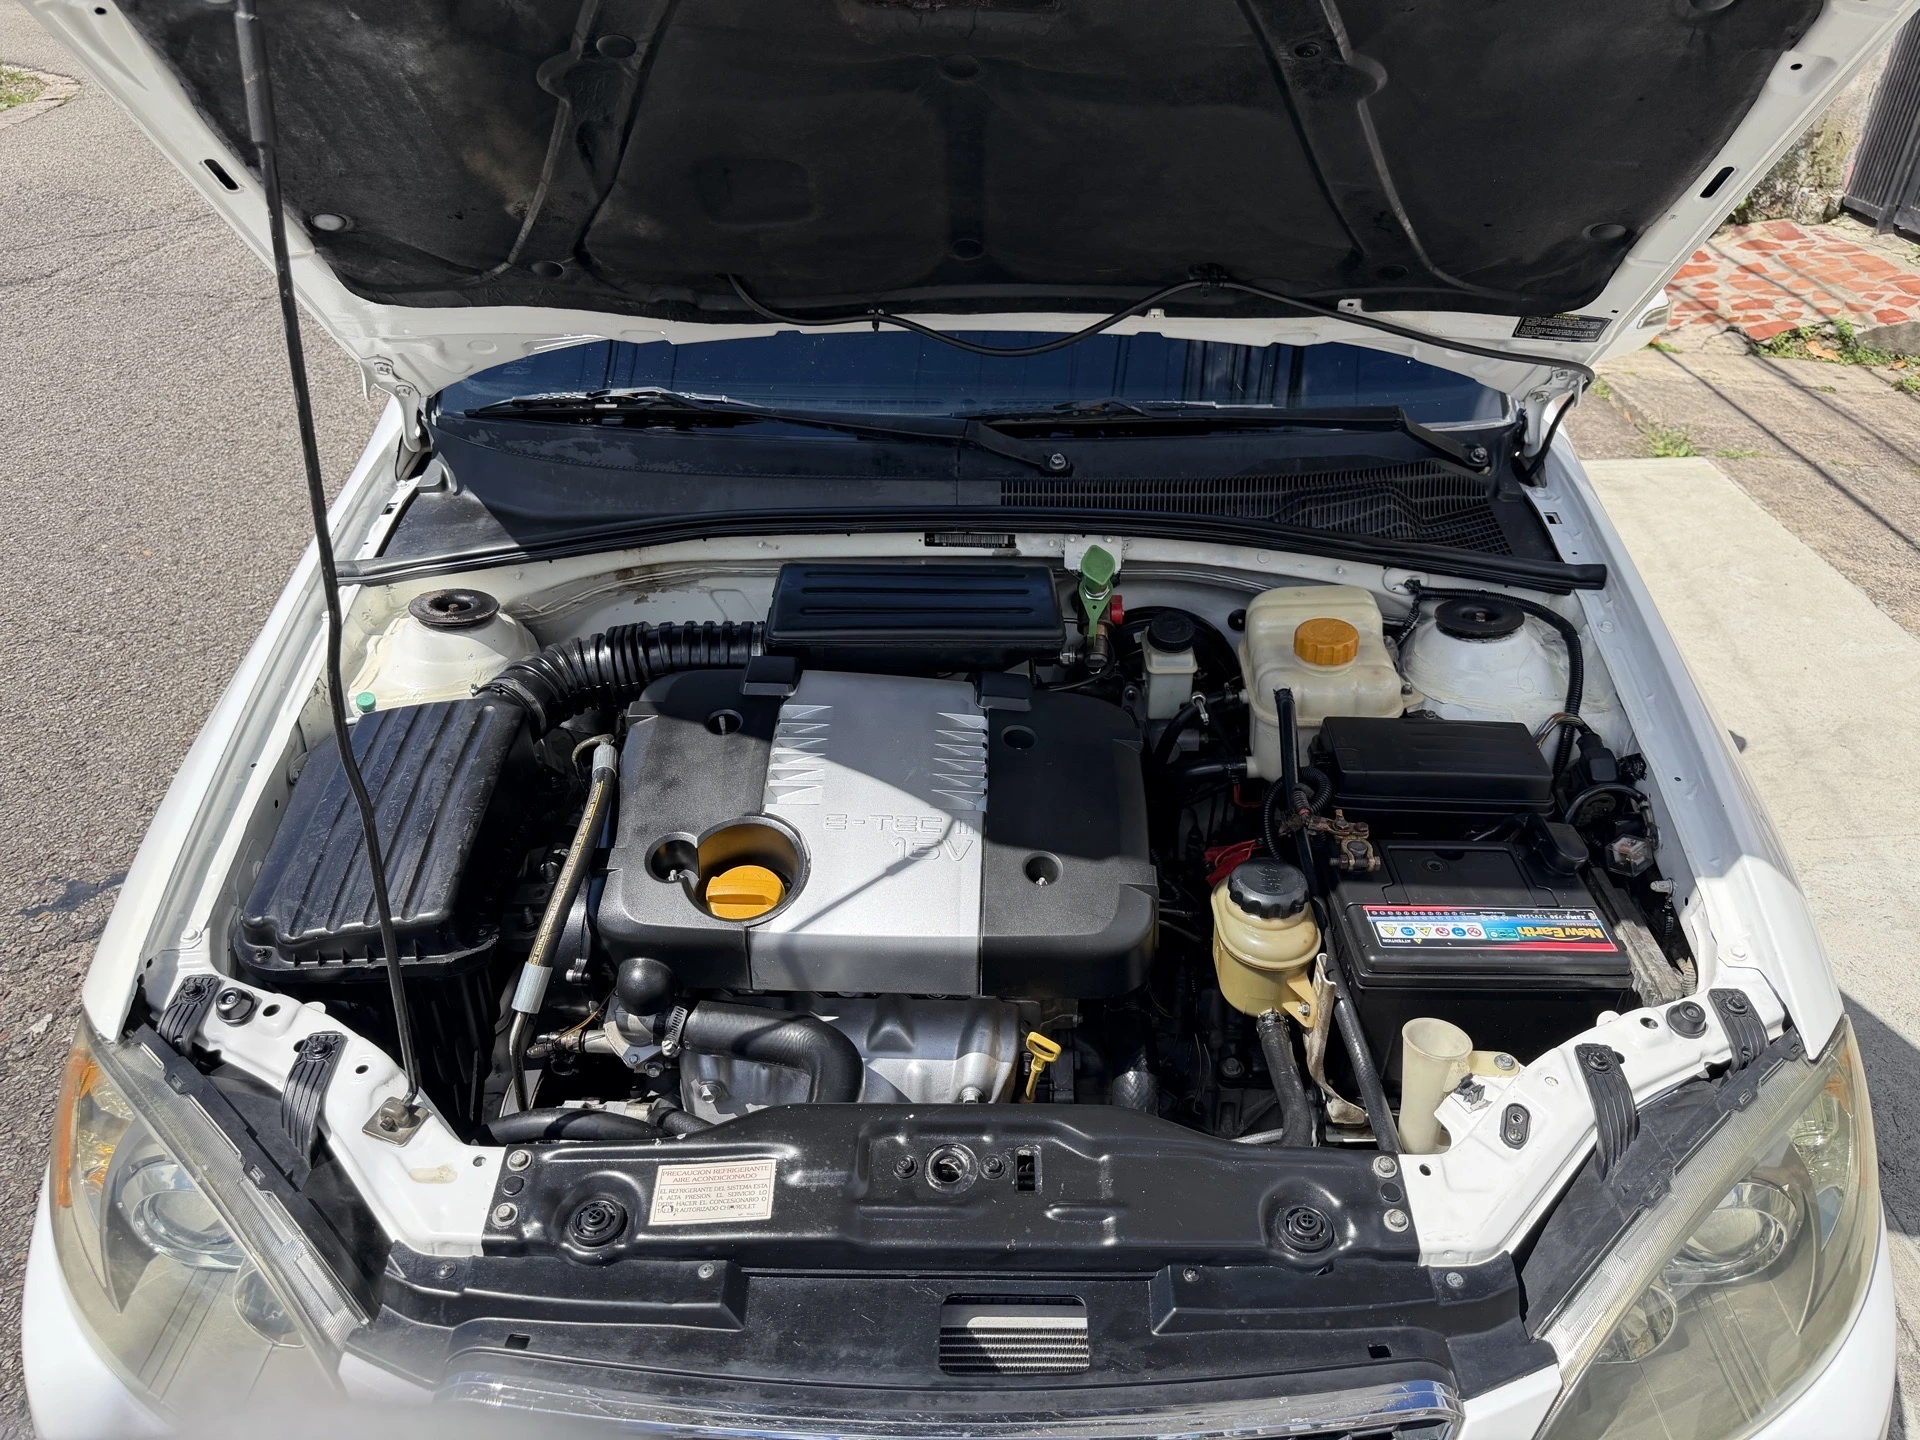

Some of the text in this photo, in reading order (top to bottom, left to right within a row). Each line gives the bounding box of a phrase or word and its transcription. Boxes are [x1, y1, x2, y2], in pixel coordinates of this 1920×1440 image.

[823, 813, 943, 833] E-TEC
[892, 836, 974, 861] 16V
[1517, 926, 1605, 938] New Earth
[662, 1166, 769, 1177] PRECAUCION REFRIGERANTE
[692, 1173, 757, 1182] ACONDICIONADO
[710, 1196, 760, 1204] CONCESIONARIO
